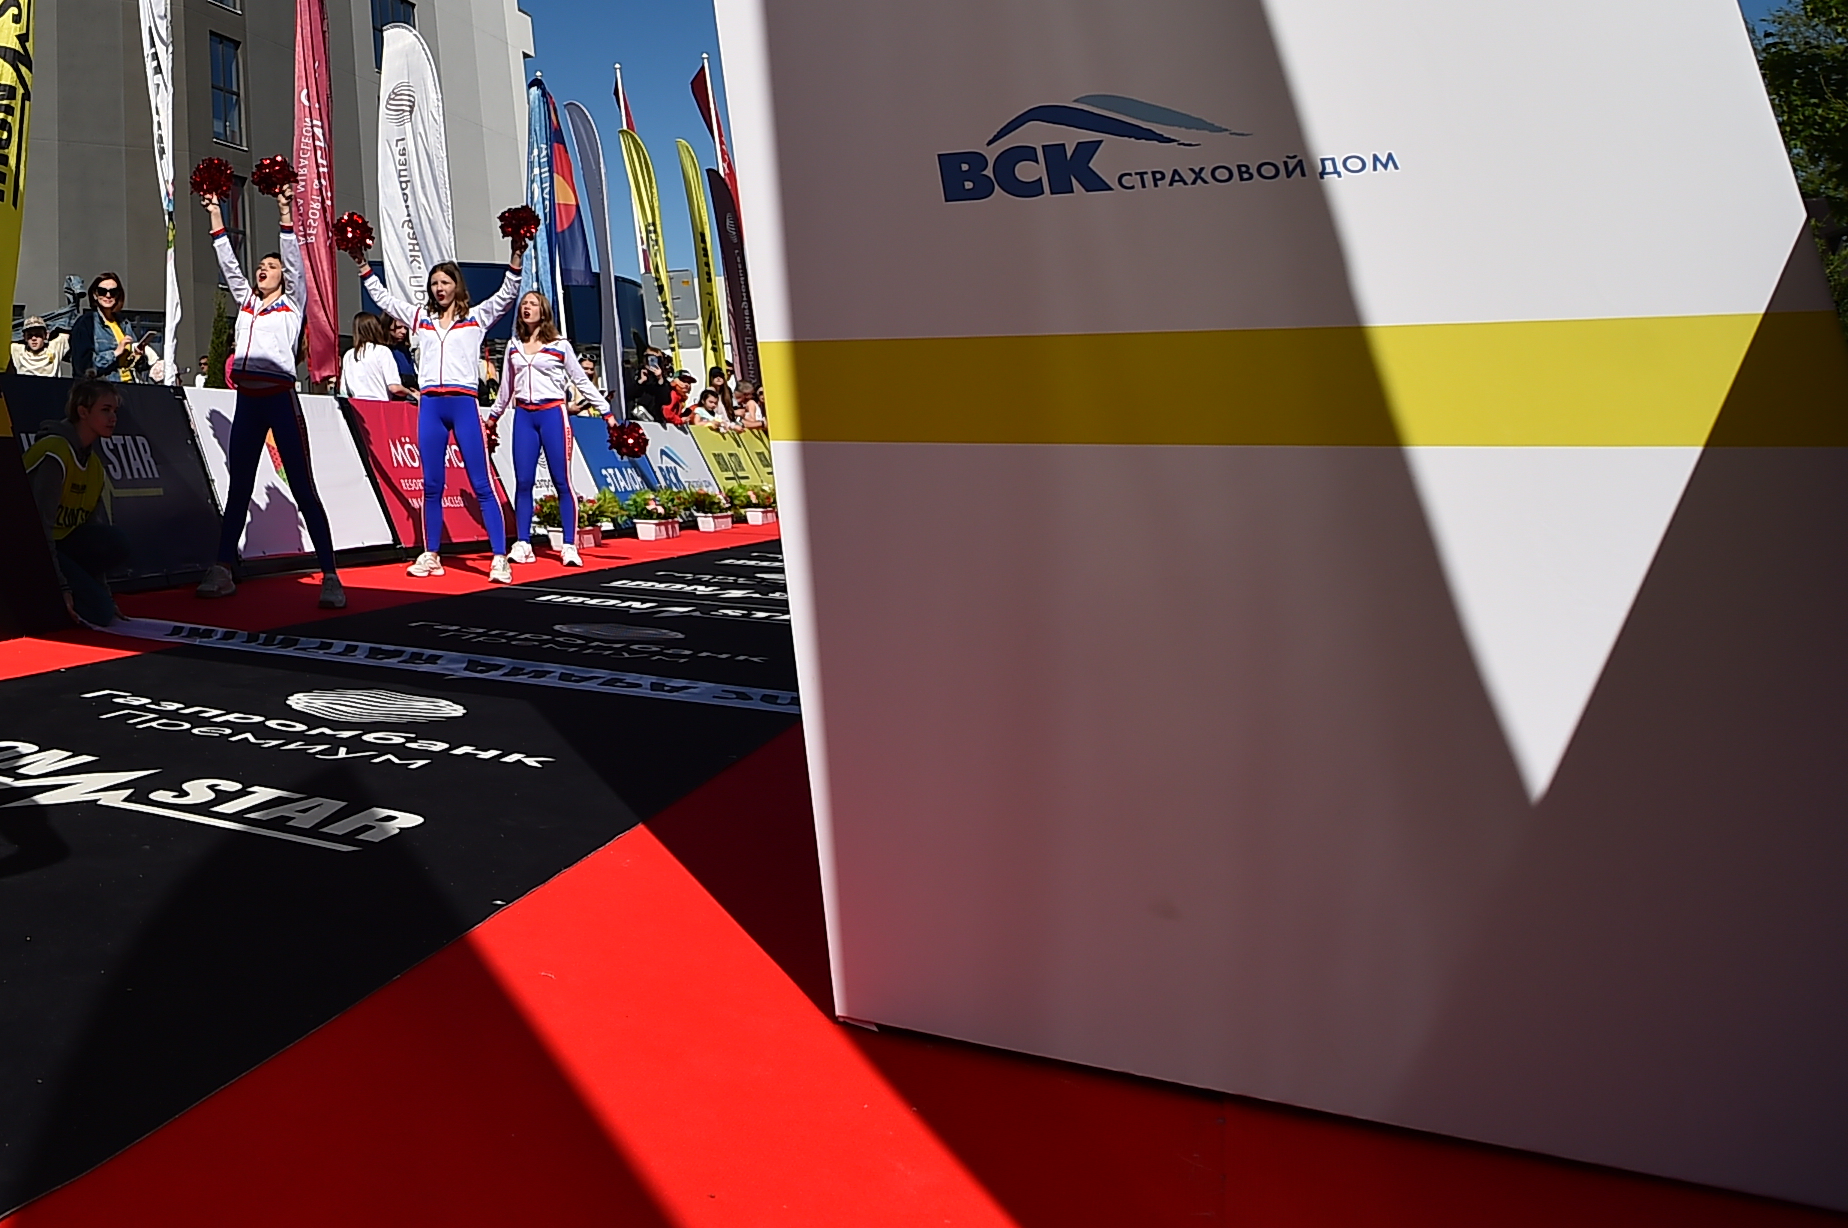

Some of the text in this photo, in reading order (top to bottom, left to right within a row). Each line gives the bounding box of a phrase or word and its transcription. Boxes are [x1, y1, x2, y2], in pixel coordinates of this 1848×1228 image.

[937, 139, 1401, 203] ВСК СТРАХОВОЙ ДОМ
[101, 435, 160, 481] STAR
[534, 595, 791, 622] IRON STA
[79, 688, 555, 771] Газпромбанк
[98, 709, 432, 770] Премиум
[150, 777, 426, 844] STAR
